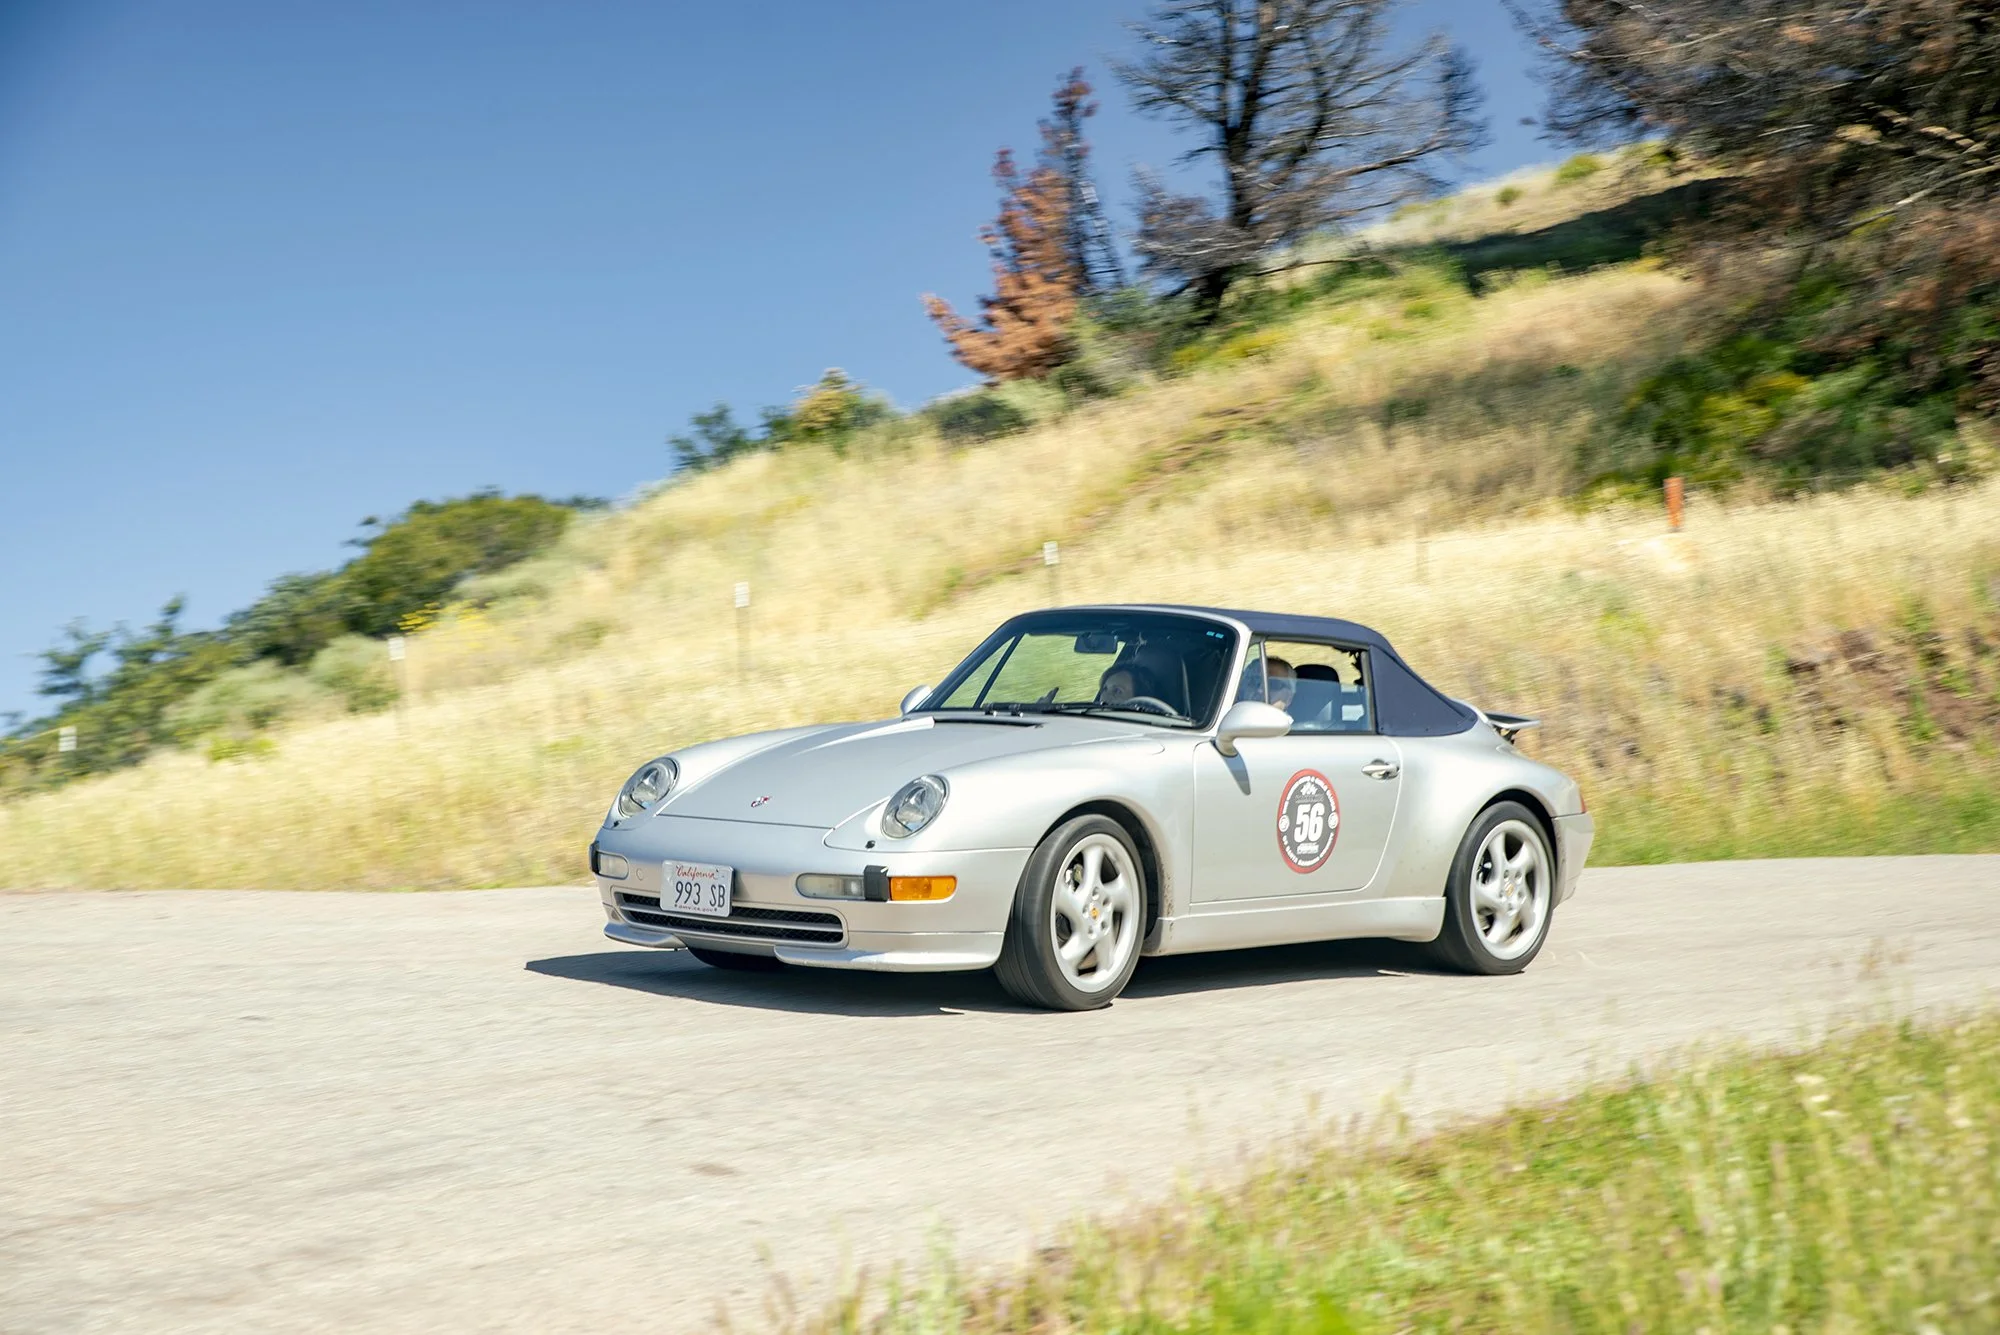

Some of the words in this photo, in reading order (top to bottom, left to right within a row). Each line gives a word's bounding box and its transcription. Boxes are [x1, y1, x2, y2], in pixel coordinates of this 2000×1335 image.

[1294, 802, 1325, 843] 56
[676, 865, 718, 881] California
[675, 881, 701, 905] 993
[709, 884, 726, 908] SB
